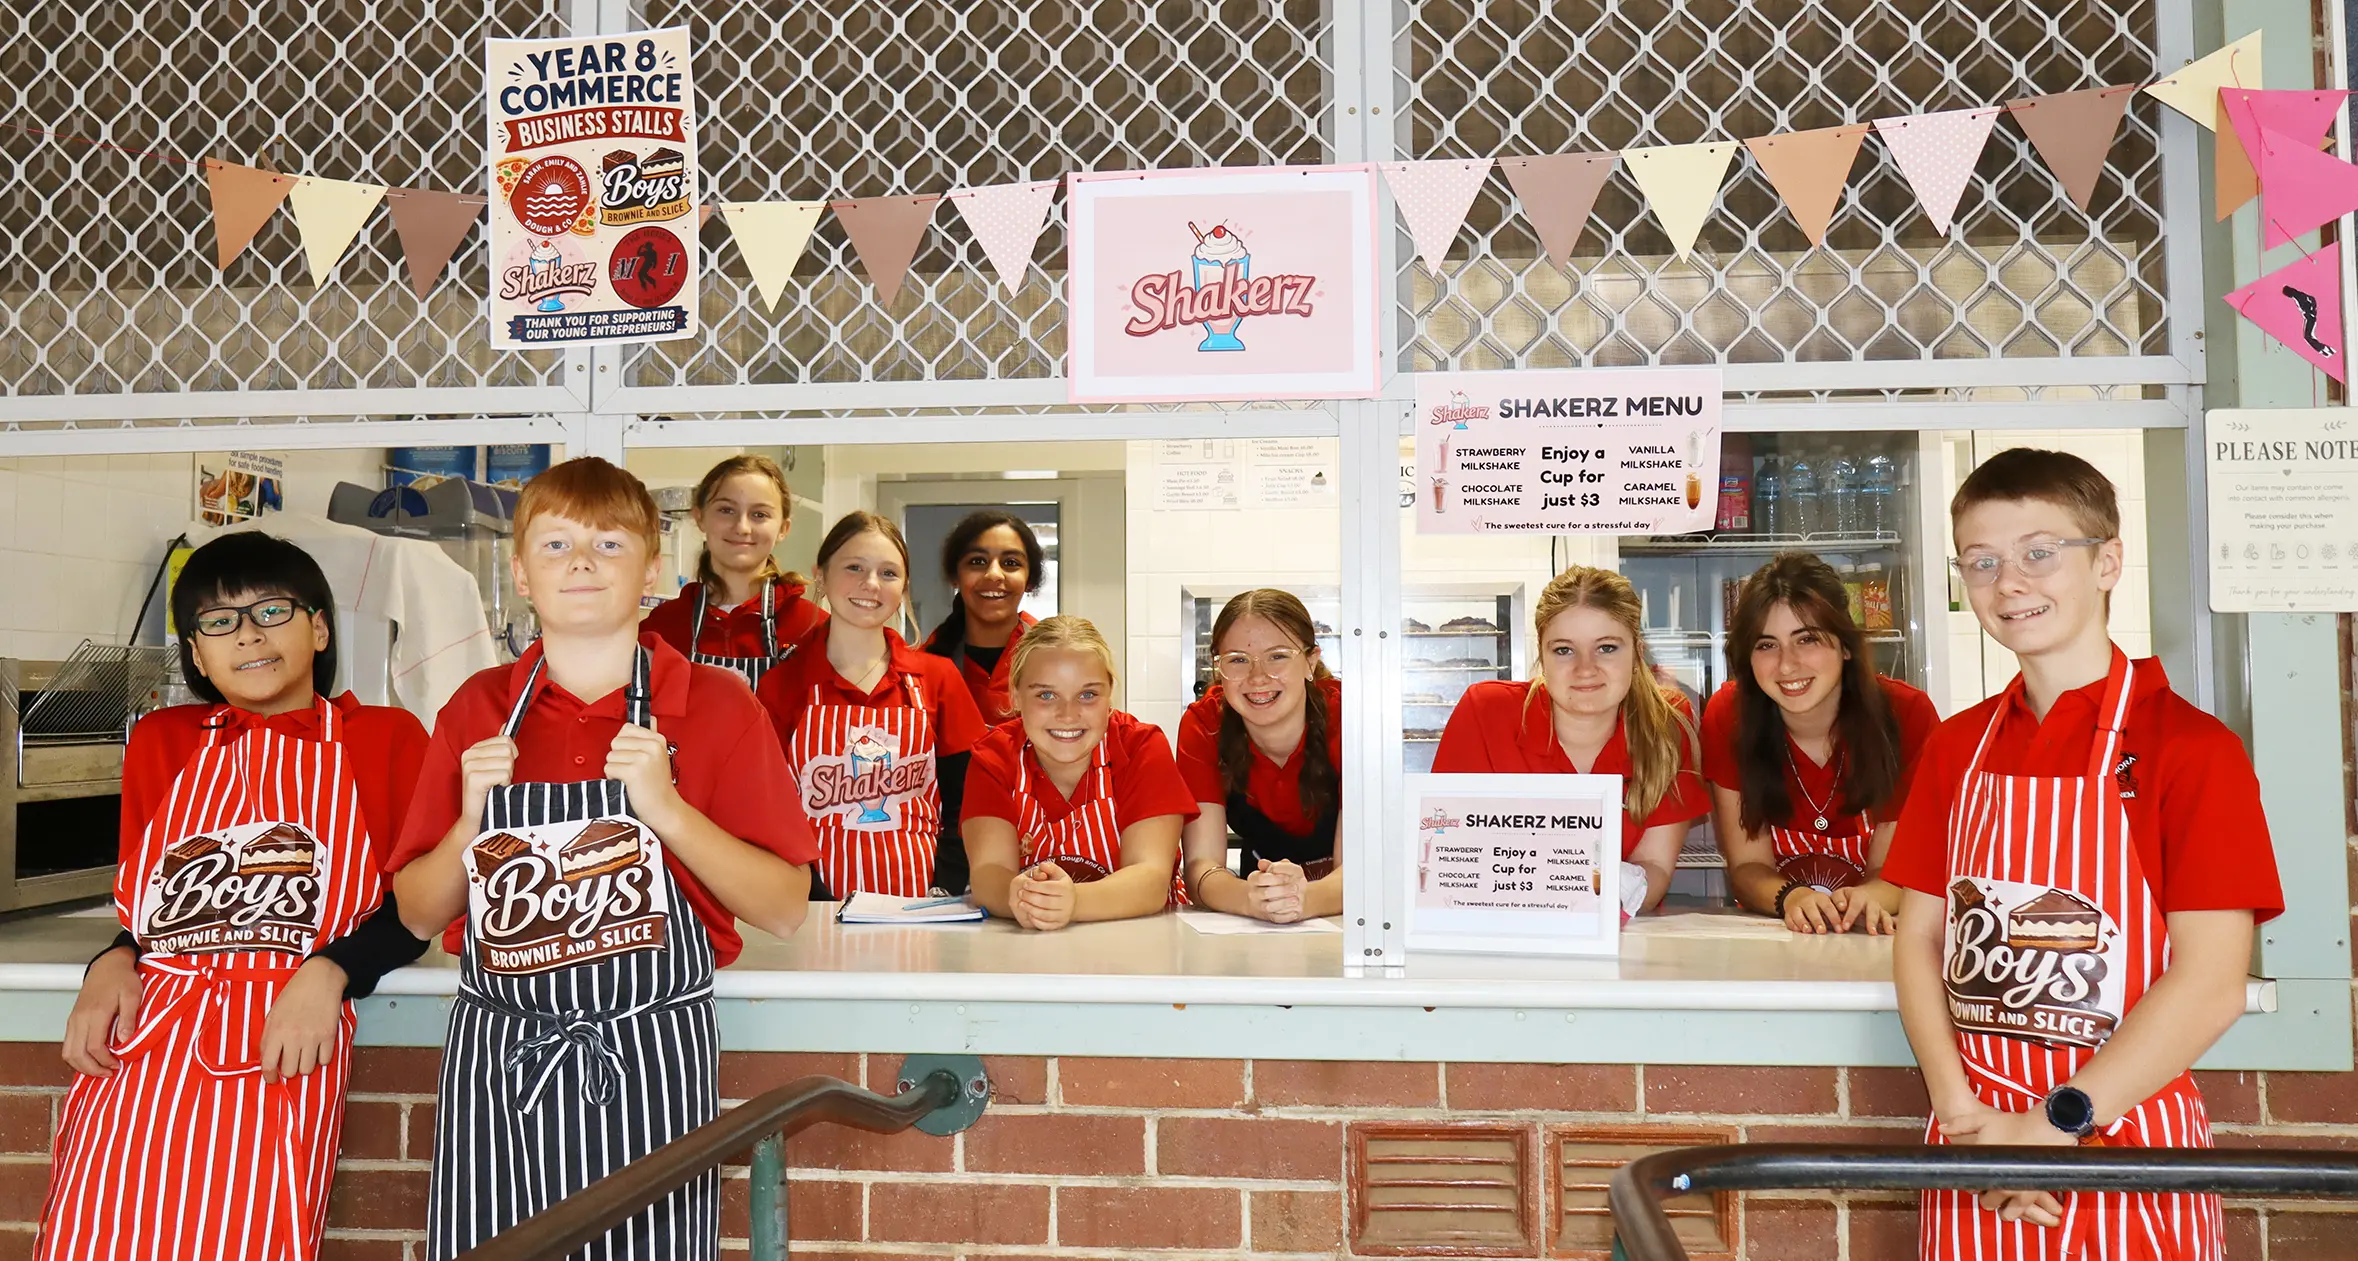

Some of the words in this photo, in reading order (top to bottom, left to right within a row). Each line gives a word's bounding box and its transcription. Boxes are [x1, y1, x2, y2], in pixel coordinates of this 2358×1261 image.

[527, 43, 626, 81] YEAR
[635, 39, 656, 72] 8
[500, 73, 681, 115] COMMERCE
[518, 110, 606, 146] BUSINESS
[612, 110, 673, 135] STALLS
[544, 159, 565, 167] EMILY
[565, 162, 578, 172] AND
[601, 165, 680, 208] Boys
[608, 209, 643, 221] BROWNIE
[662, 203, 683, 216] SLICE
[525, 219, 552, 233] DOUGH
[562, 218, 572, 228] CO
[500, 262, 597, 300] Shakerz
[1125, 262, 1315, 336] Shakerz
[525, 317, 563, 329] THANK
[565, 315, 587, 327] YOU
[589, 313, 609, 325] FOR
[612, 310, 675, 324] SUPPORTING
[527, 328, 548, 340] OUR
[552, 326, 588, 338] YOUNG
[590, 321, 675, 336] ENTREPRENEURS!
[1431, 403, 1490, 425] Shakerz
[1500, 397, 1618, 418] SHAKERZ
[1626, 397, 1703, 417] MENU
[1456, 448, 1526, 457] STRAWBERRY
[1541, 446, 1589, 462] Enjoy
[1594, 449, 1605, 460] a
[1628, 446, 1675, 454] VANILLA
[2216, 441, 2297, 461] PLEASE
[2306, 440, 2358, 460] NOTE
[1461, 462, 1520, 471] MILKSHAKE
[1621, 460, 1682, 469] MILKSHAKE
[1540, 470, 1574, 487] Cup
[1579, 470, 1605, 483] for
[1461, 484, 1523, 493] CHOCOLATE
[1623, 483, 1676, 492] CARAMEL
[1463, 497, 1520, 506] MILKSHAKE
[1541, 493, 1576, 510] just
[1580, 493, 1600, 509] $3
[1619, 496, 1680, 506] MILKSHAKE
[809, 759, 929, 810] Shakerz
[1420, 816, 1460, 831] Shakerz
[1466, 814, 1546, 829] SHAKERZ
[1551, 816, 1602, 829] MENU
[1436, 846, 1483, 854] STRAWBERRY
[1493, 847, 1525, 859] Enjoy
[1085, 860, 1098, 868] and
[1492, 864, 1515, 876] Cup
[1519, 864, 1537, 874] for
[151, 853, 313, 928] Boys
[1493, 881, 1516, 892] just
[1520, 881, 1533, 892] $3
[485, 855, 643, 938] Boys
[224, 930, 254, 942] AND
[490, 941, 562, 969] BROWNIE
[566, 939, 596, 958] AND
[602, 923, 653, 948] SLICE
[1950, 908, 2096, 1008] Boys
[1998, 1011, 2028, 1026] AND
[2034, 1011, 2096, 1039] SLICE
